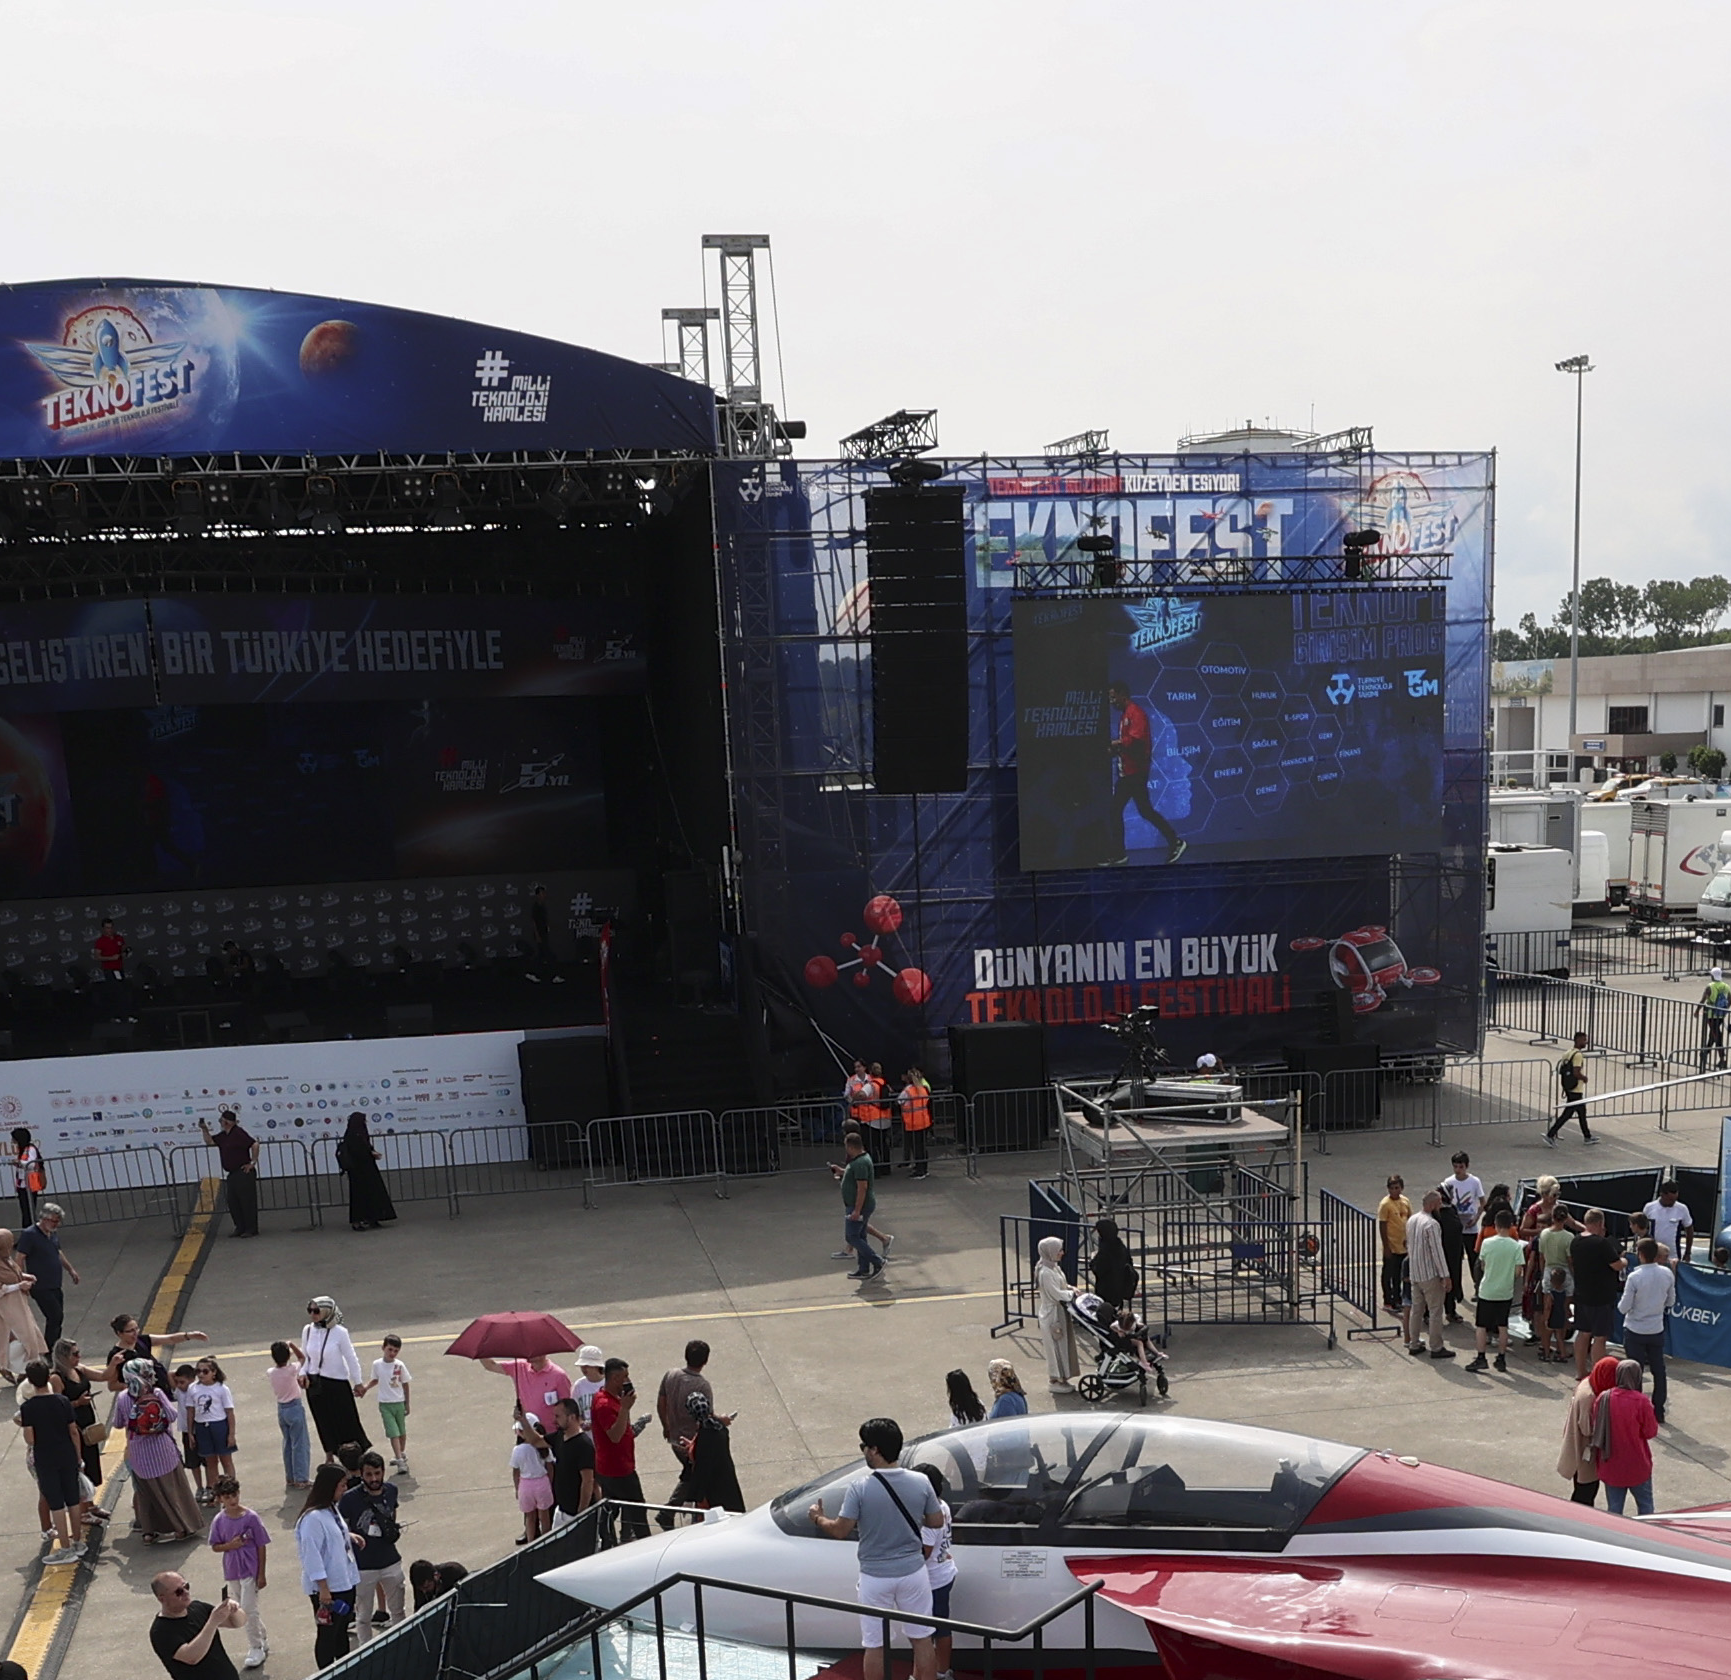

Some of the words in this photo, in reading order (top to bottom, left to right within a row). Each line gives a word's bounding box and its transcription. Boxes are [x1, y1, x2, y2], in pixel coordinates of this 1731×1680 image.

[41, 359, 195, 431] TEKNOFEST
[472, 391, 549, 407] TEKNOLOJİ
[483, 406, 547, 422] HAMLESİ
[1125, 474, 1189, 493] KUZEYDEN
[967, 498, 1294, 588] EKNOFEST
[1132, 611, 1202, 650] TEKNOFEST
[1382, 621, 1445, 659] PROG
[161, 630, 215, 675] BİR
[221, 629, 350, 674] TÜRKİYE
[354, 628, 504, 672] HEDEFİYLE
[1200, 664, 1247, 675] OTOMOTİV
[1166, 691, 1197, 702] TARIM
[1212, 716, 1242, 728] EĞİTİM
[974, 940, 1126, 989] DÜNYANIN
[1135, 937, 1172, 980] EN
[1181, 932, 1279, 977] BÜYÜK
[965, 983, 1131, 1026] TEKNOLOJİ
[1140, 974, 1292, 1020] FESTİVALİ
[1670, 1301, 1721, 1326] ÖKBEY
